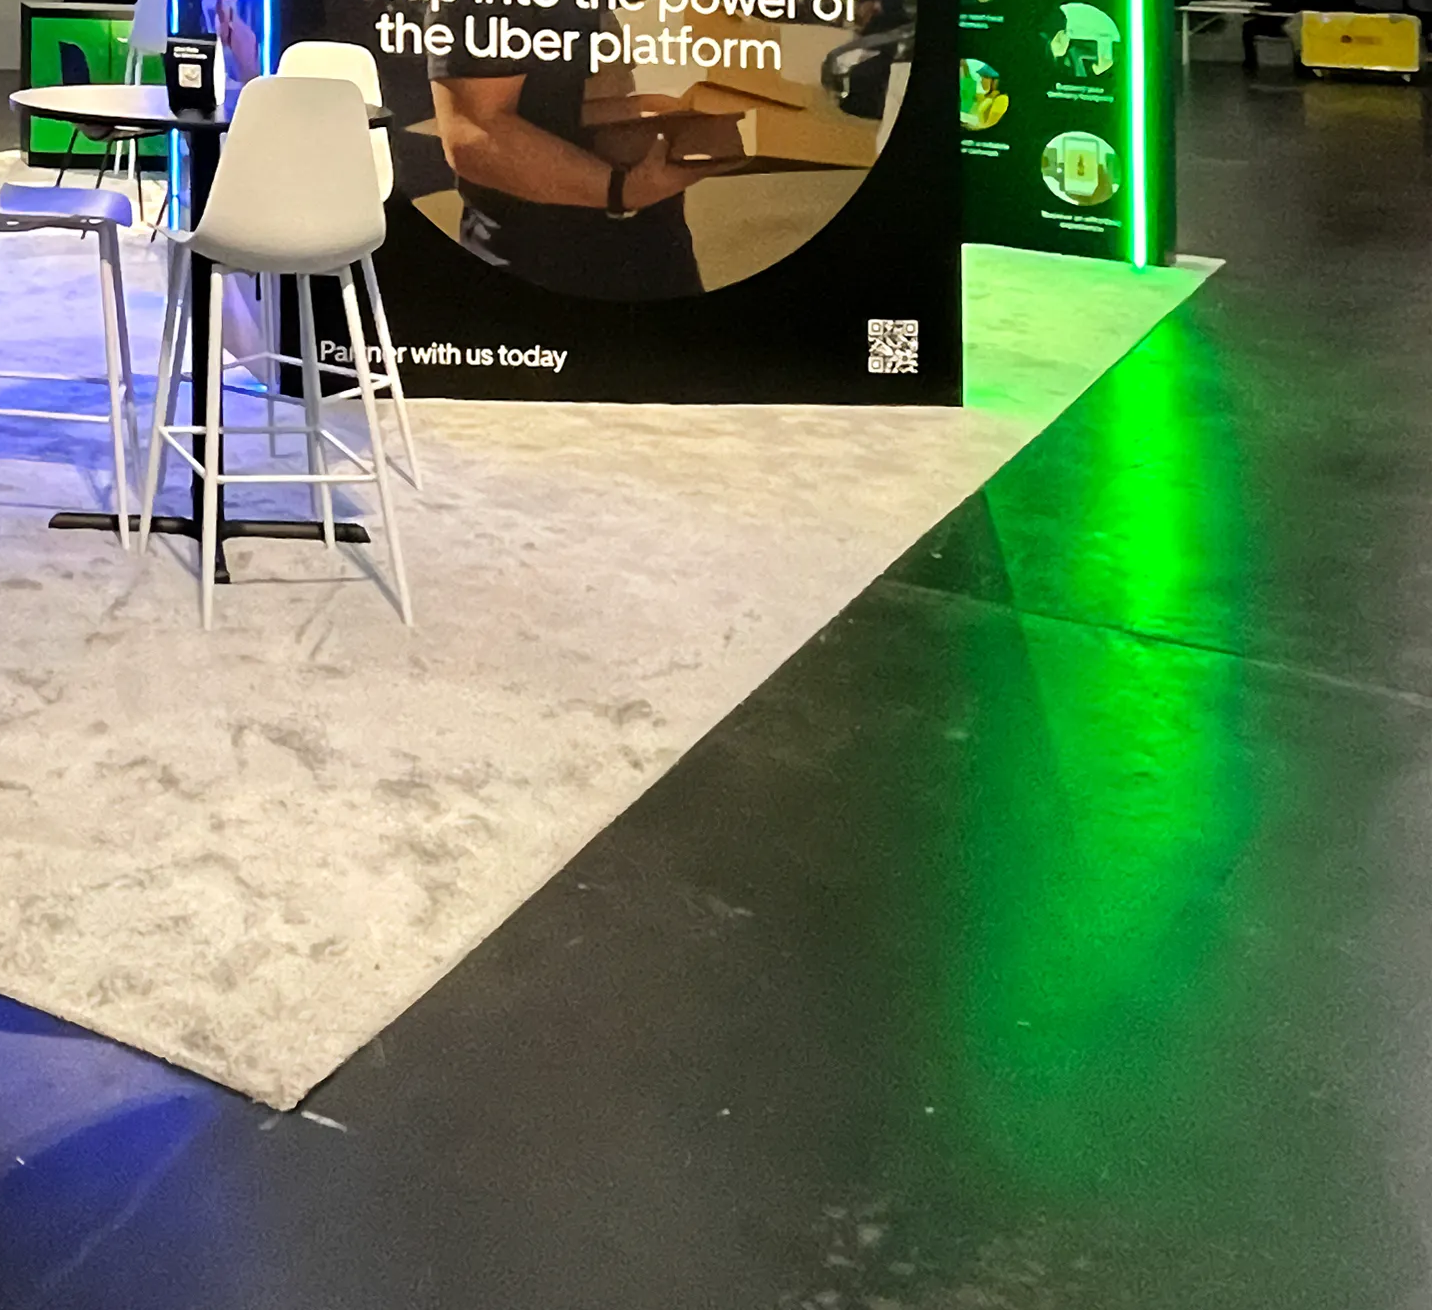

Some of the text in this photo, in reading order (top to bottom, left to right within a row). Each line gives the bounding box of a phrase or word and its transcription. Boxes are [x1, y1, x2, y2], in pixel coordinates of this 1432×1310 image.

[375, 12, 782, 74] the Uber platform
[411, 341, 461, 366] with
[465, 348, 493, 366] us
[497, 344, 568, 374] today
